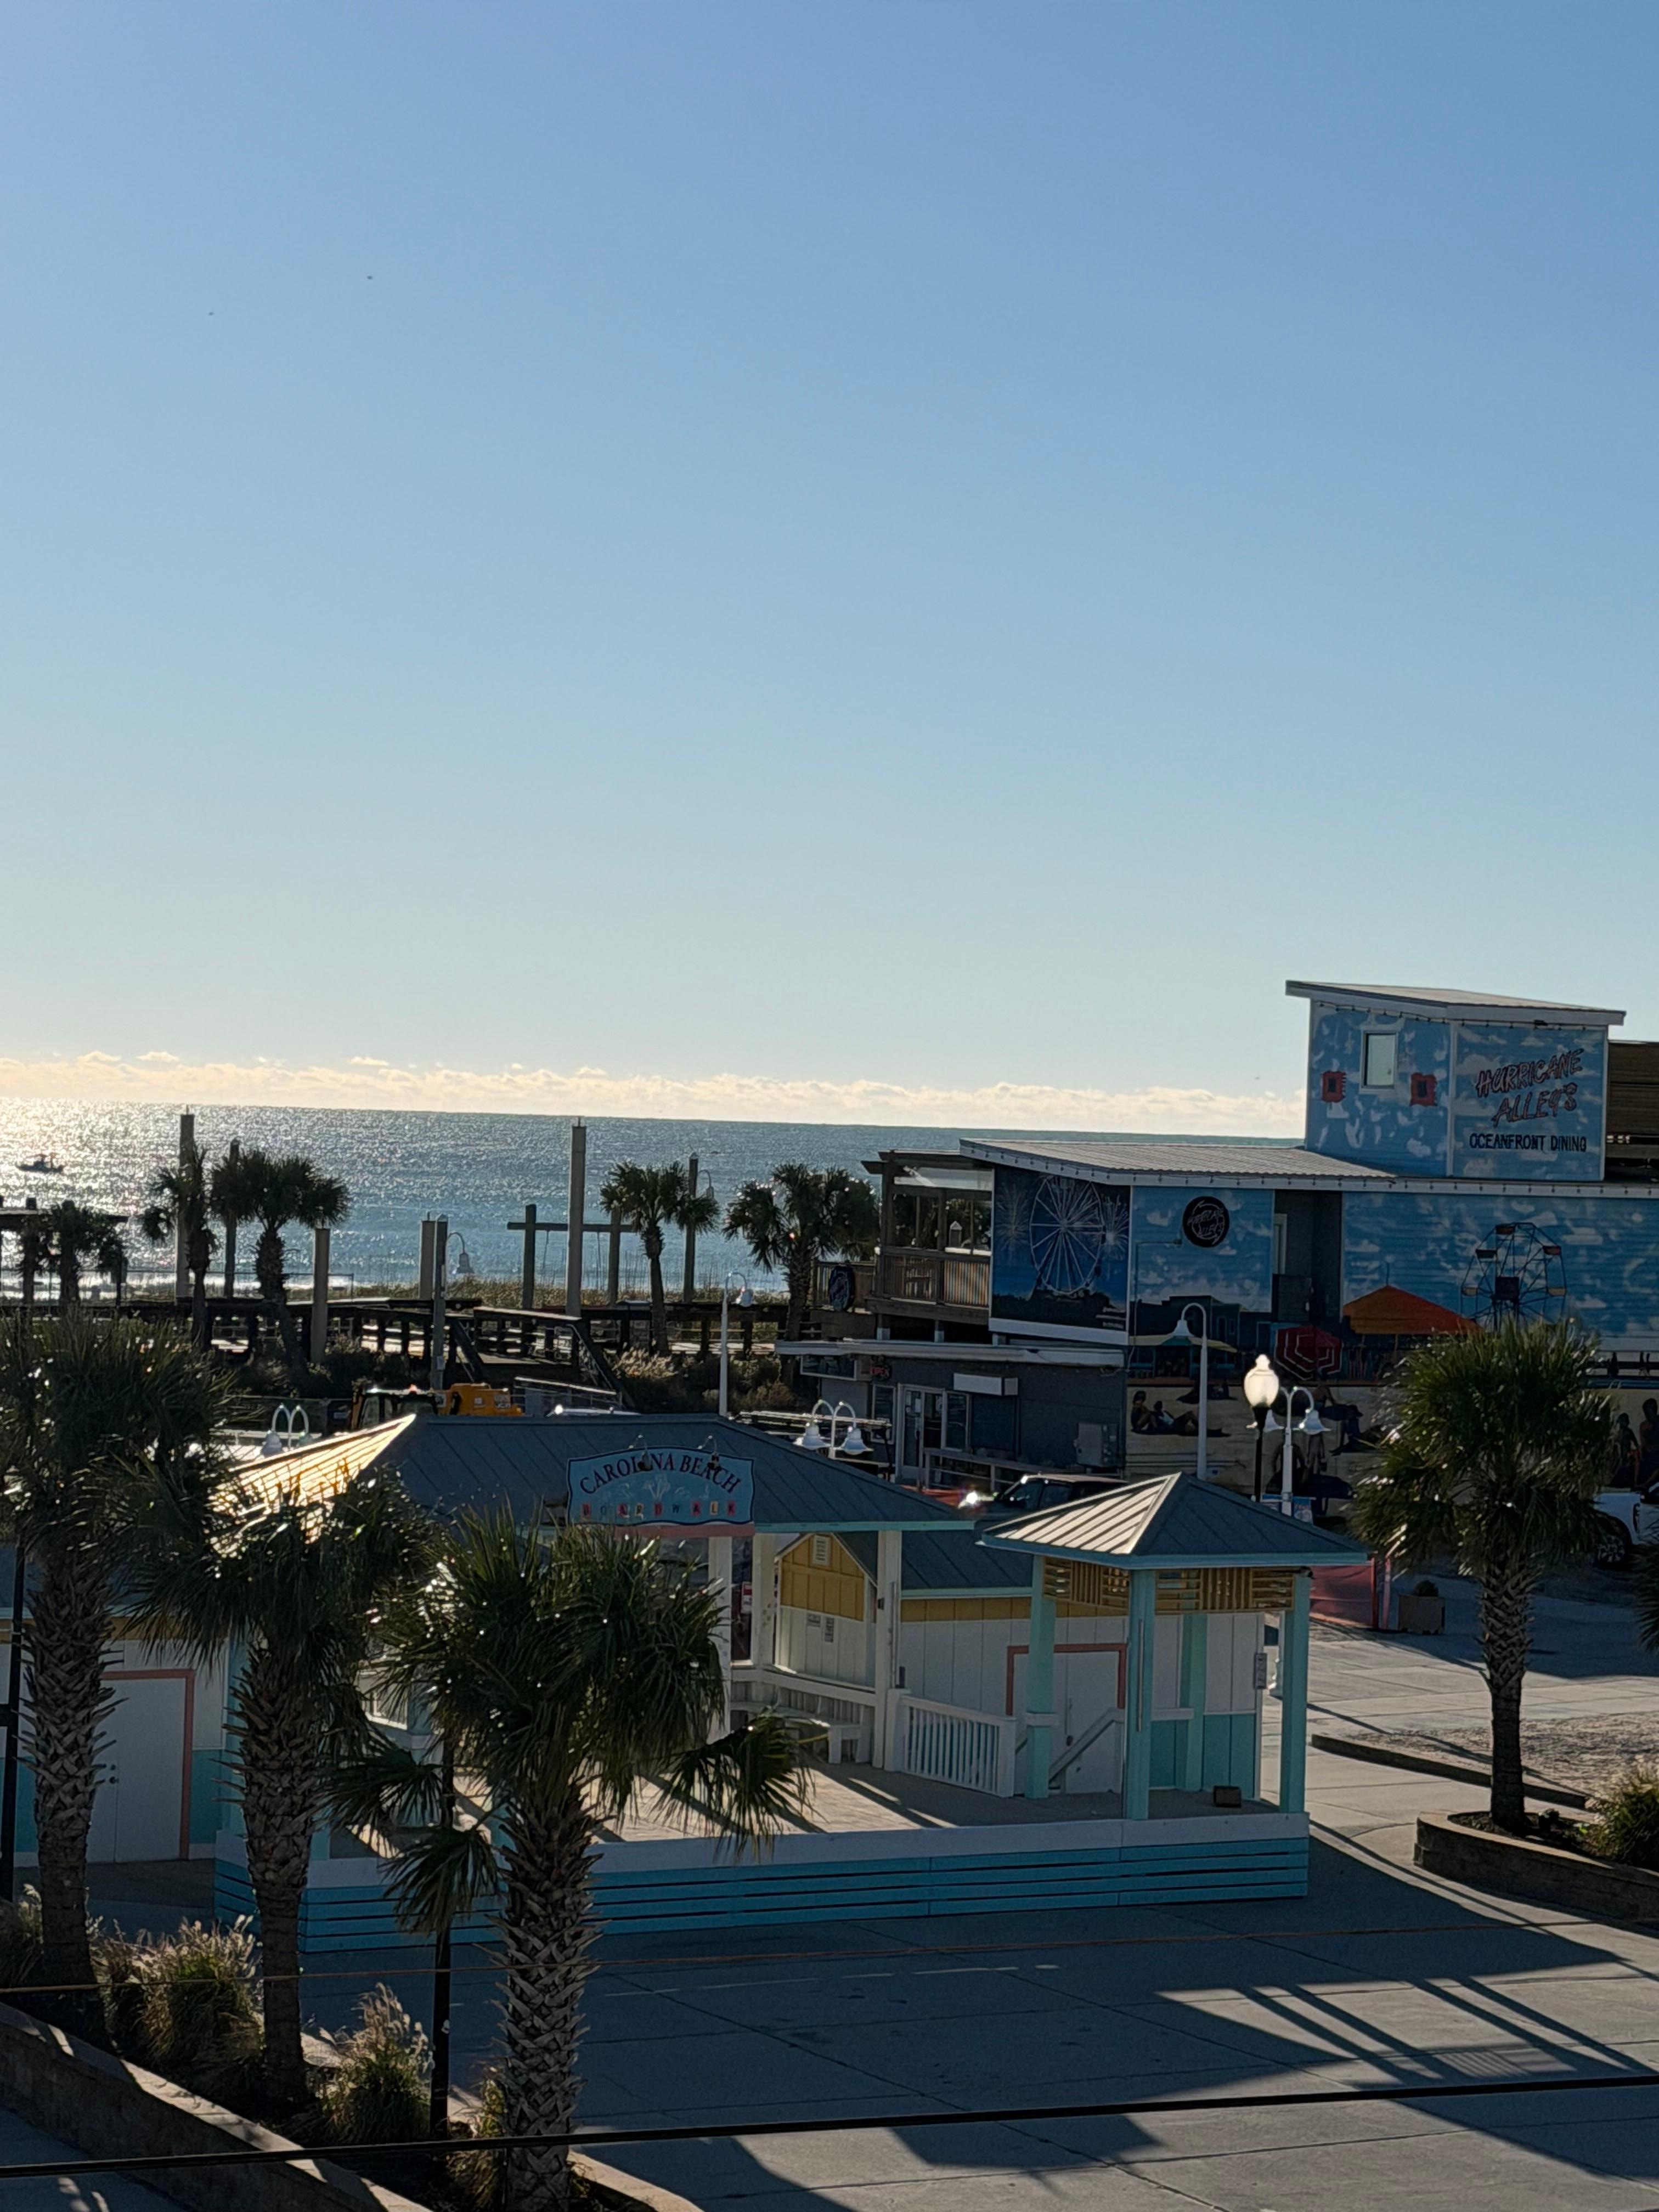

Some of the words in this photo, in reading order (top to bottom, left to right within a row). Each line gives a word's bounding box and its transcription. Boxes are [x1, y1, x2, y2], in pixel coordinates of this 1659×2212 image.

[1475, 1048, 1584, 1098] HURRICANE
[1469, 1132, 1546, 1150] OCEANFRONT
[1550, 1135, 1587, 1152] DINING
[580, 1453, 674, 1494] CAROLNA
[583, 1502, 736, 1516] BOARDWALK
